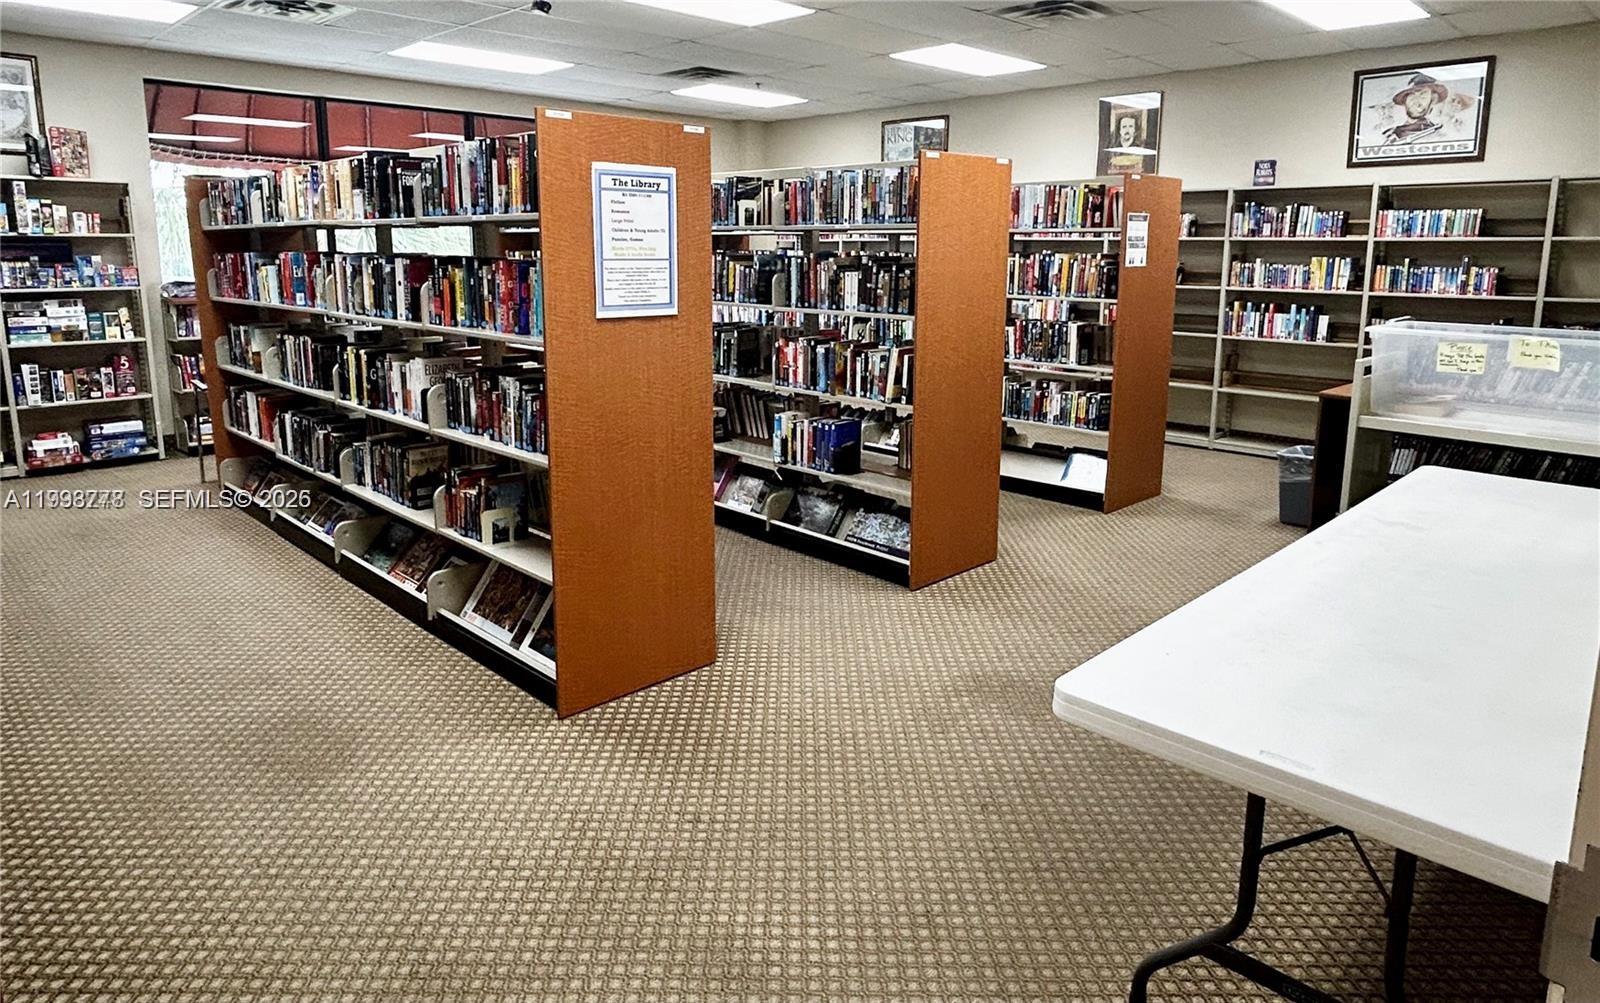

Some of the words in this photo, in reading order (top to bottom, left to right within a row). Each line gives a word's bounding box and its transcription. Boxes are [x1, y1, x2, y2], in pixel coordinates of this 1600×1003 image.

[1361, 142, 1469, 156] Westerns
[611, 178, 628, 187] The
[631, 179, 661, 191] Library
[119, 355, 129, 369] 5
